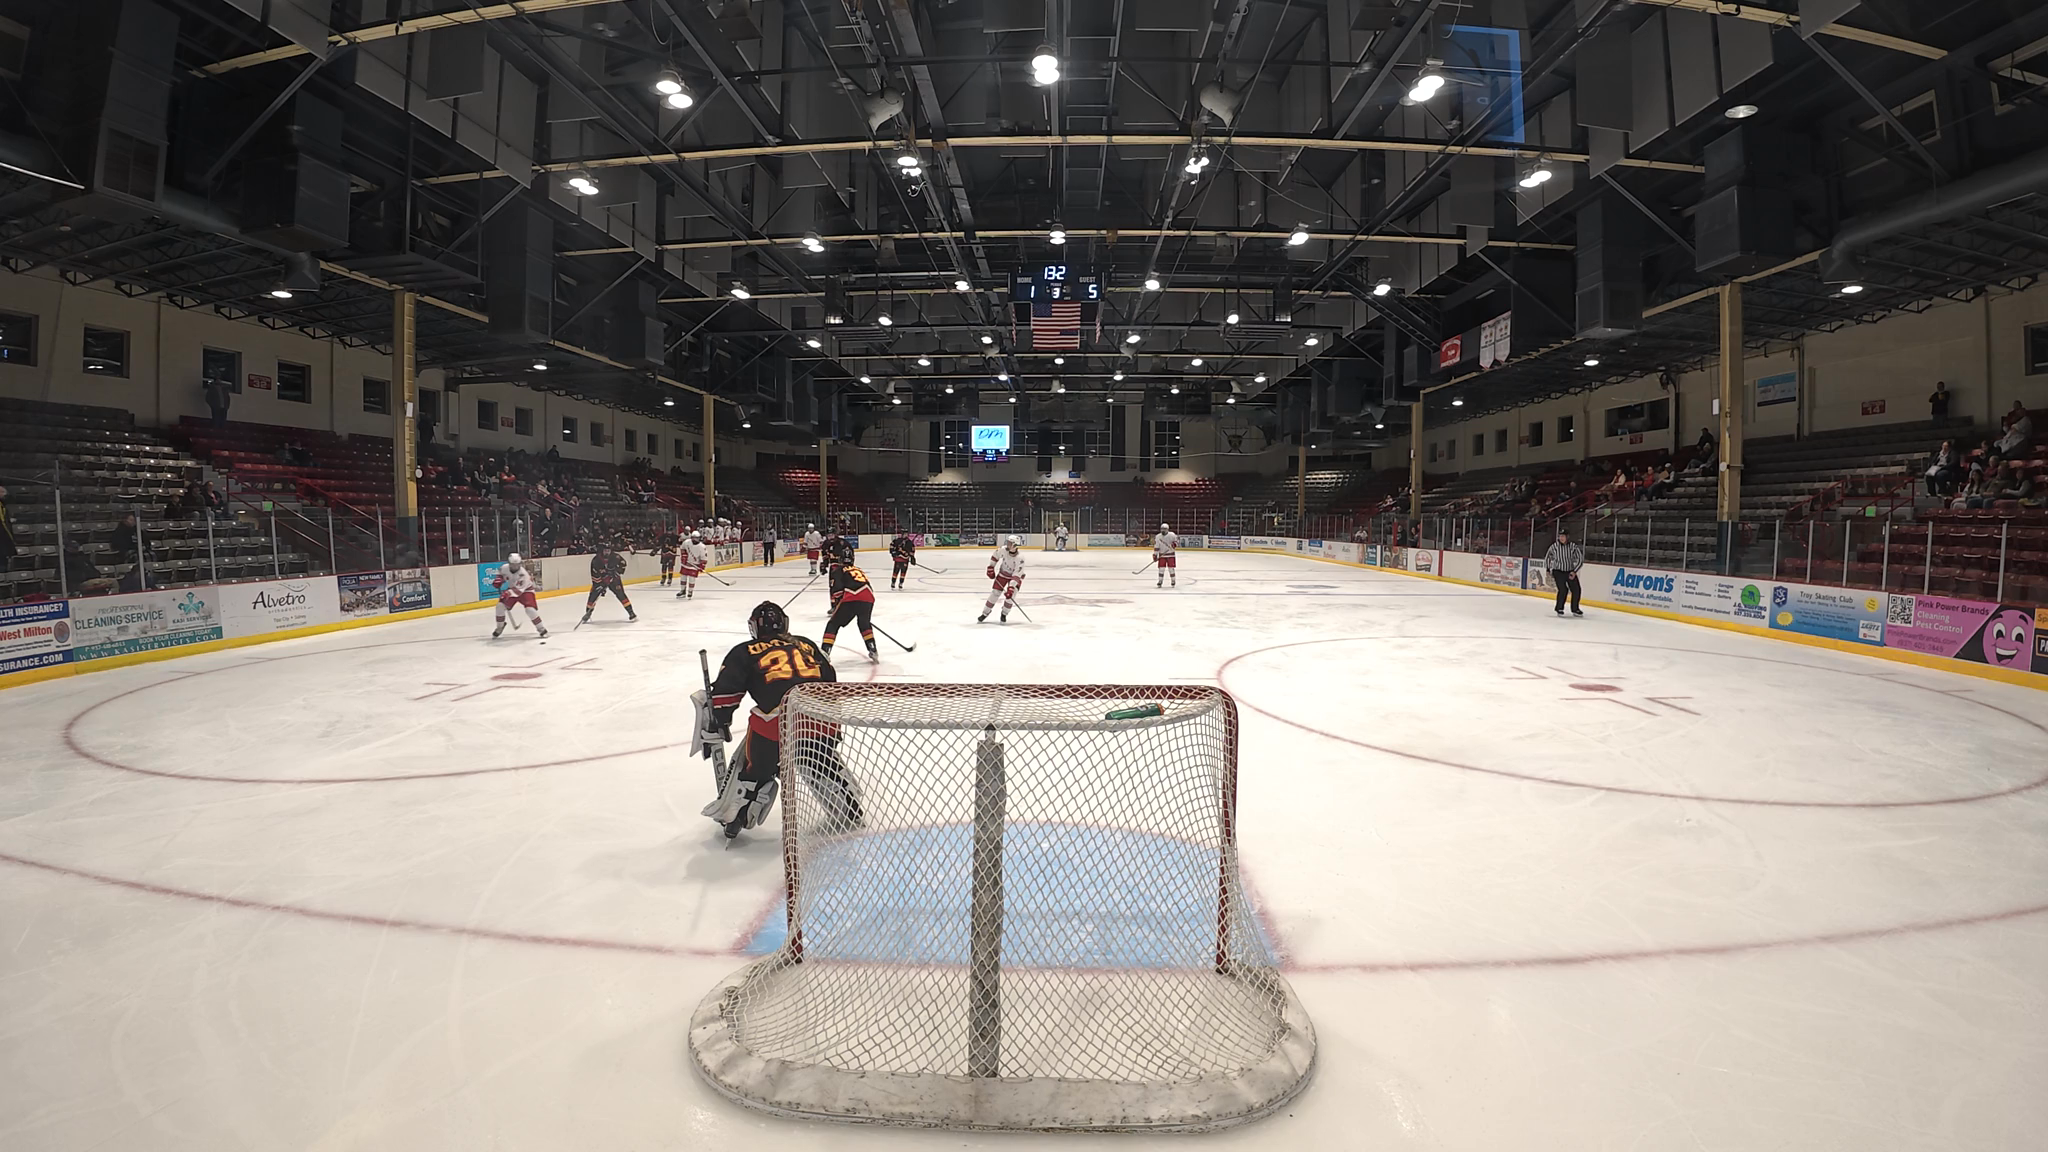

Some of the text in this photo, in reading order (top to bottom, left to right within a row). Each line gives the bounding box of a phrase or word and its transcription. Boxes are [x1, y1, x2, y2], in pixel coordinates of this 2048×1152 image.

[1088, 284, 1097, 298] 5
[1613, 568, 1675, 593] Aaron's
[252, 591, 306, 610] Alvetro
[402, 594, 426, 603] Comfort
[1800, 591, 1854, 603] Troy Skating Club
[15, 603, 63, 616] INSURANCE?
[1917, 600, 1989, 616] Pink Power Brands
[75, 610, 164, 630] CLEANING SERVICE
[1917, 611, 1950, 623] Cleaning
[23, 626, 52, 638] Milton
[1915, 620, 1963, 634] Pest Control
[717, 759, 735, 800] VAUGHN
